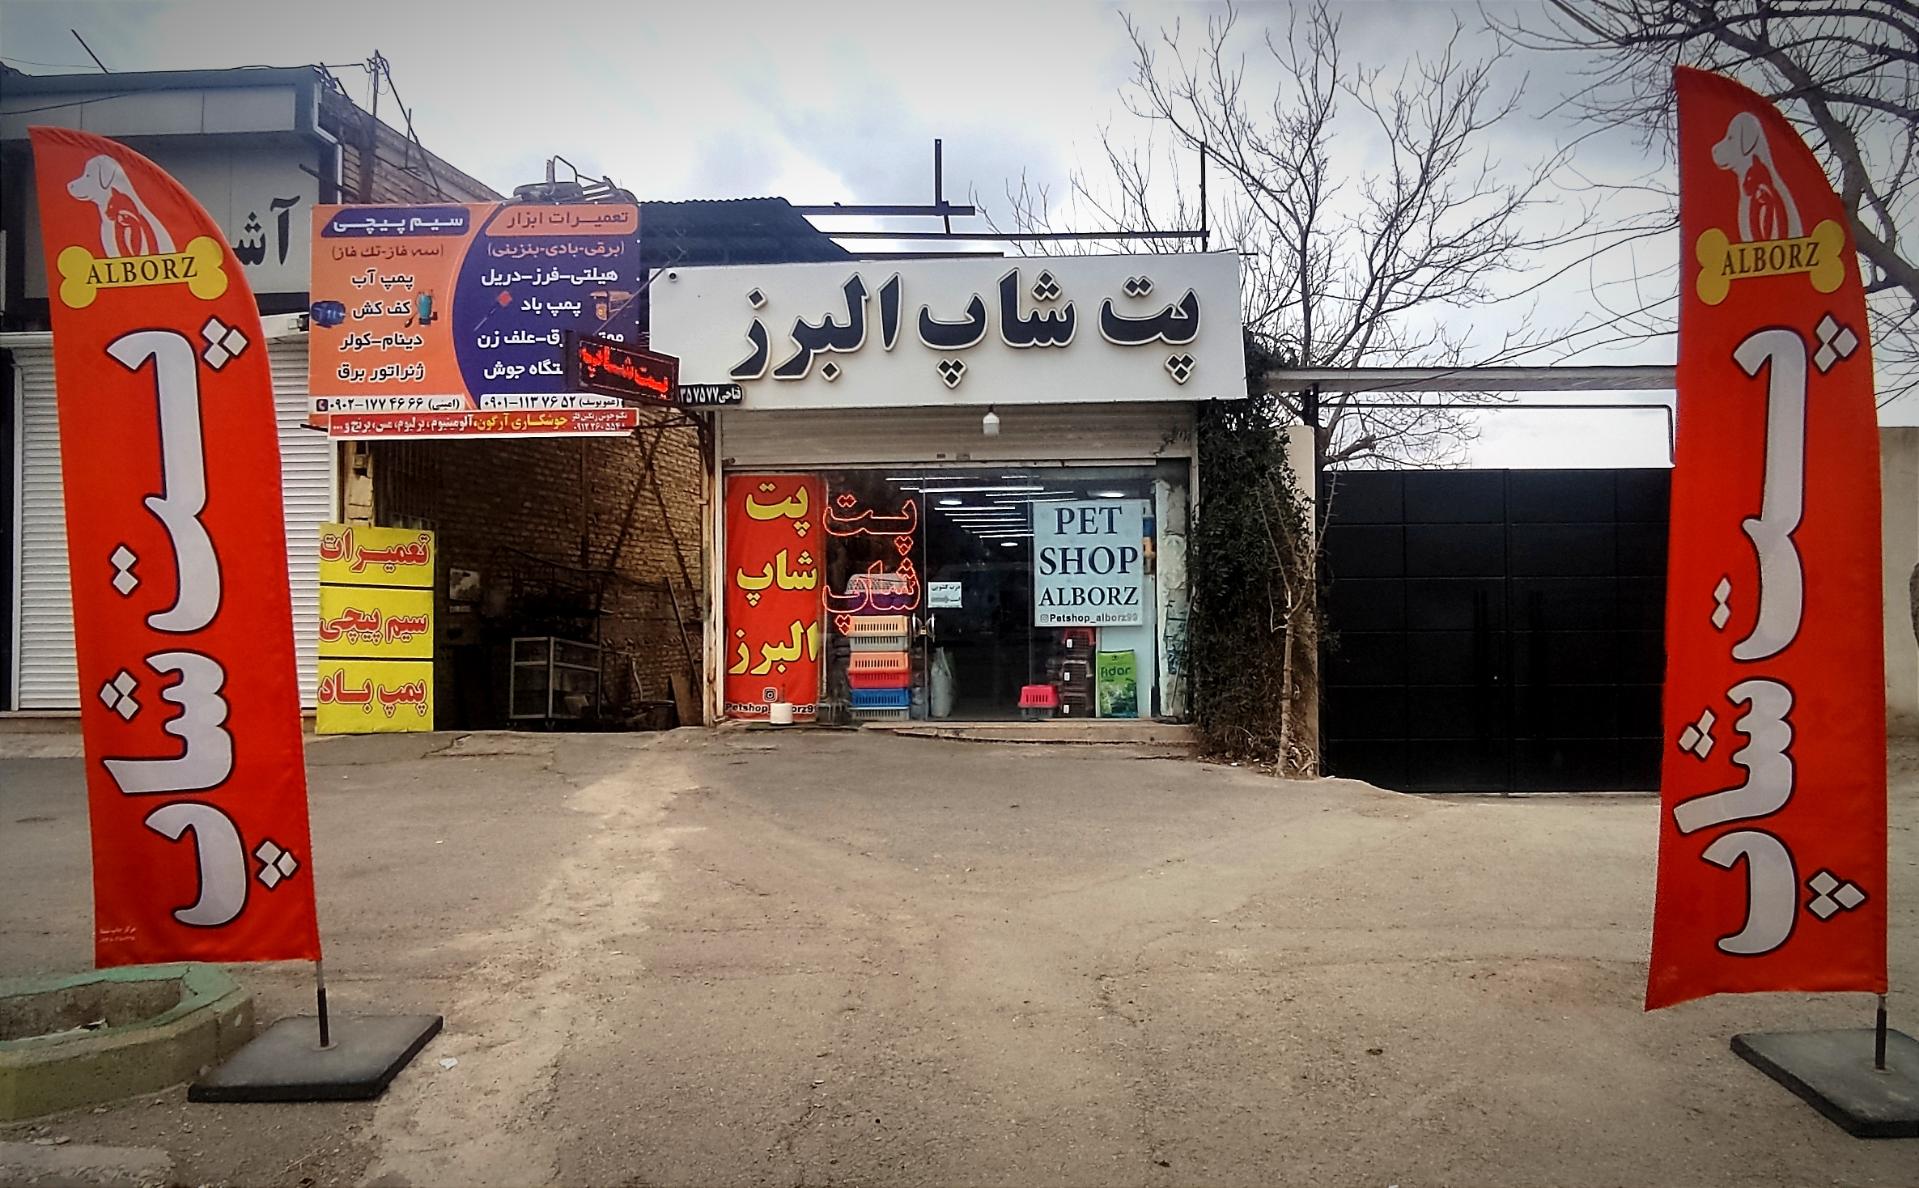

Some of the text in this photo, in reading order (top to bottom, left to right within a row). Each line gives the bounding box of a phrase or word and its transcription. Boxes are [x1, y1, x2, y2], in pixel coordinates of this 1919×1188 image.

[231, 195, 301, 266] آش
[333, 216, 464, 235] سیم پیچی
[506, 211, 629, 228] تعمیرات ابزار
[86, 255, 198, 285] ALBORZ
[1720, 241, 1821, 276] ALBORZ
[352, 269, 414, 290] پمپ آب
[352, 300, 411, 318] کف کش
[521, 296, 581, 317] پمپ باد
[477, 330, 500, 348] زن
[729, 266, 1200, 389] پت شاپ البرز
[337, 362, 425, 381] ژنراتور برق
[483, 359, 526, 380] جوش
[511, 413, 568, 431] جوشکاری
[746, 482, 811, 537] پت
[822, 494, 918, 556] پت
[1054, 506, 1122, 535] PET
[319, 527, 430, 573] تعمیرات
[1039, 546, 1138, 576] SHOP
[736, 549, 818, 607] شاپ
[822, 557, 921, 635] شاپ
[1038, 586, 1139, 607] ALBORZ
[98, 314, 300, 929] پت شاپ
[318, 606, 429, 645] سیم پیچی
[1671, 311, 1868, 957] پت شاپ
[727, 620, 819, 676] البرز
[317, 668, 428, 718] پمپ باد
